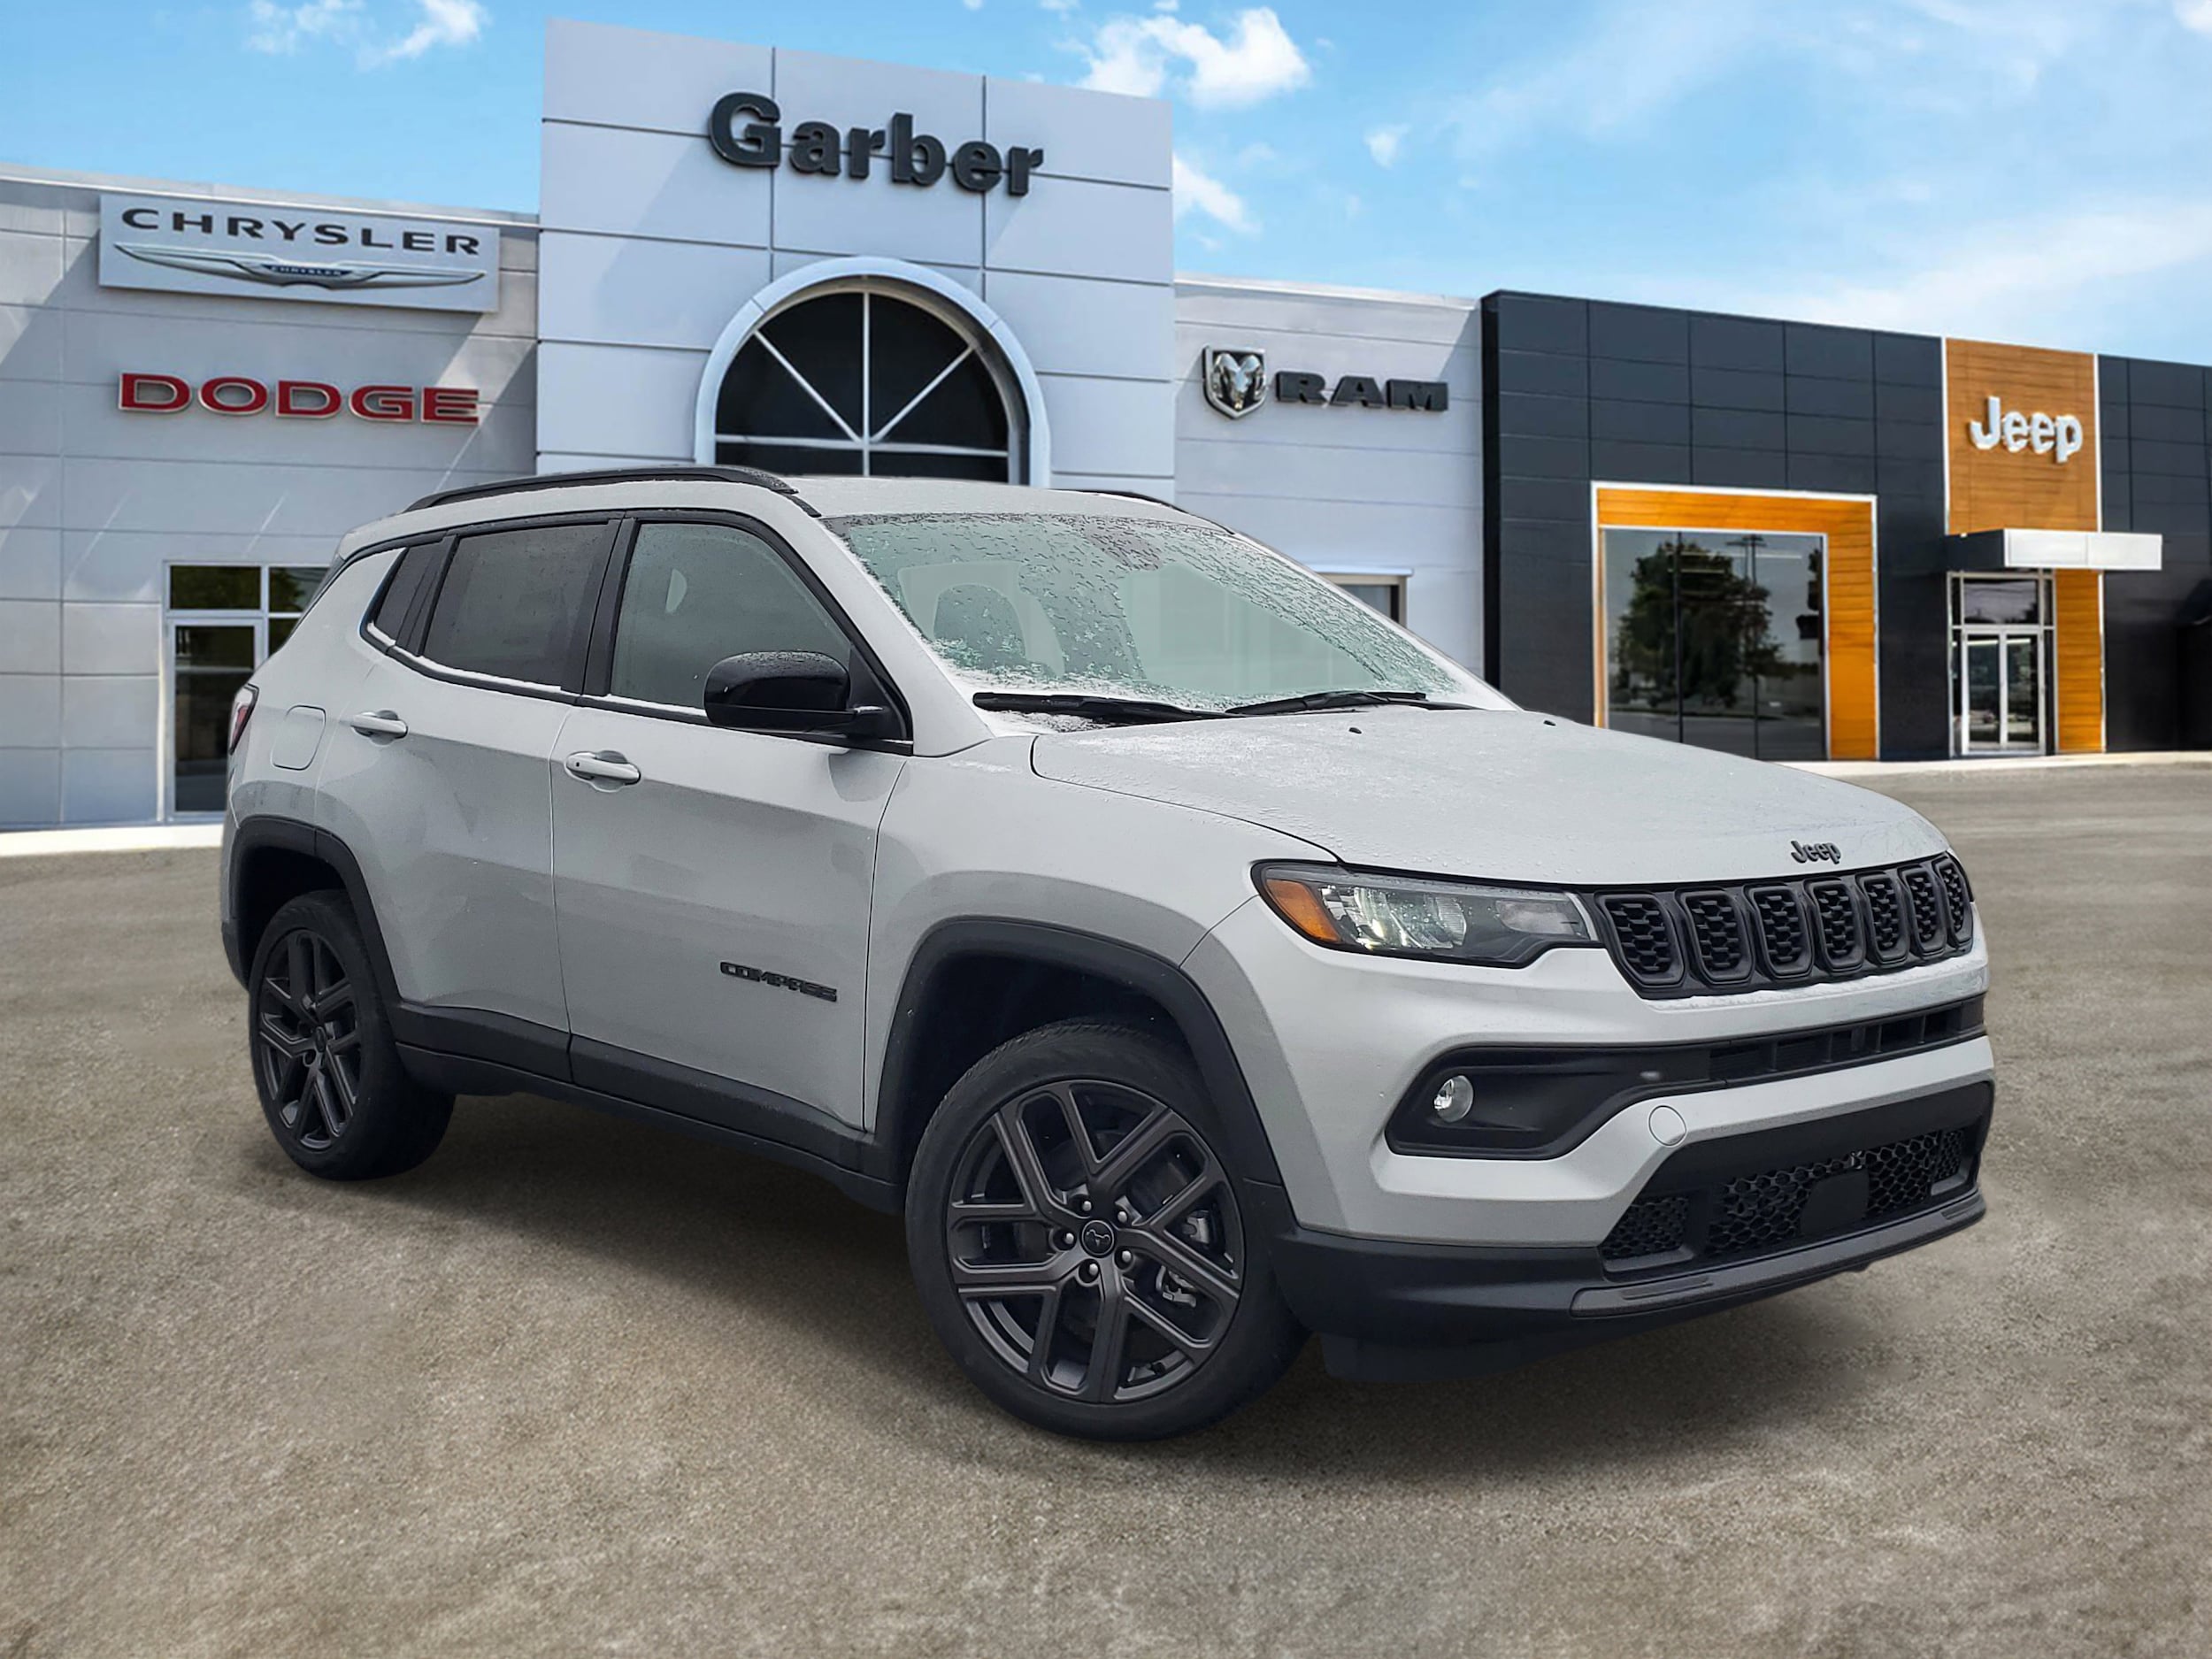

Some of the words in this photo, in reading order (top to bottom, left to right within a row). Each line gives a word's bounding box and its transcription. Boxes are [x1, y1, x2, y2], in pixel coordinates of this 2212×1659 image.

[709, 91, 1044, 196] Garber
[121, 208, 480, 255] CHRYSLER
[118, 372, 480, 425] DODGE
[1275, 370, 1449, 412] RAM
[1969, 395, 2083, 464] Jeep
[1790, 840, 1841, 865] Jeep
